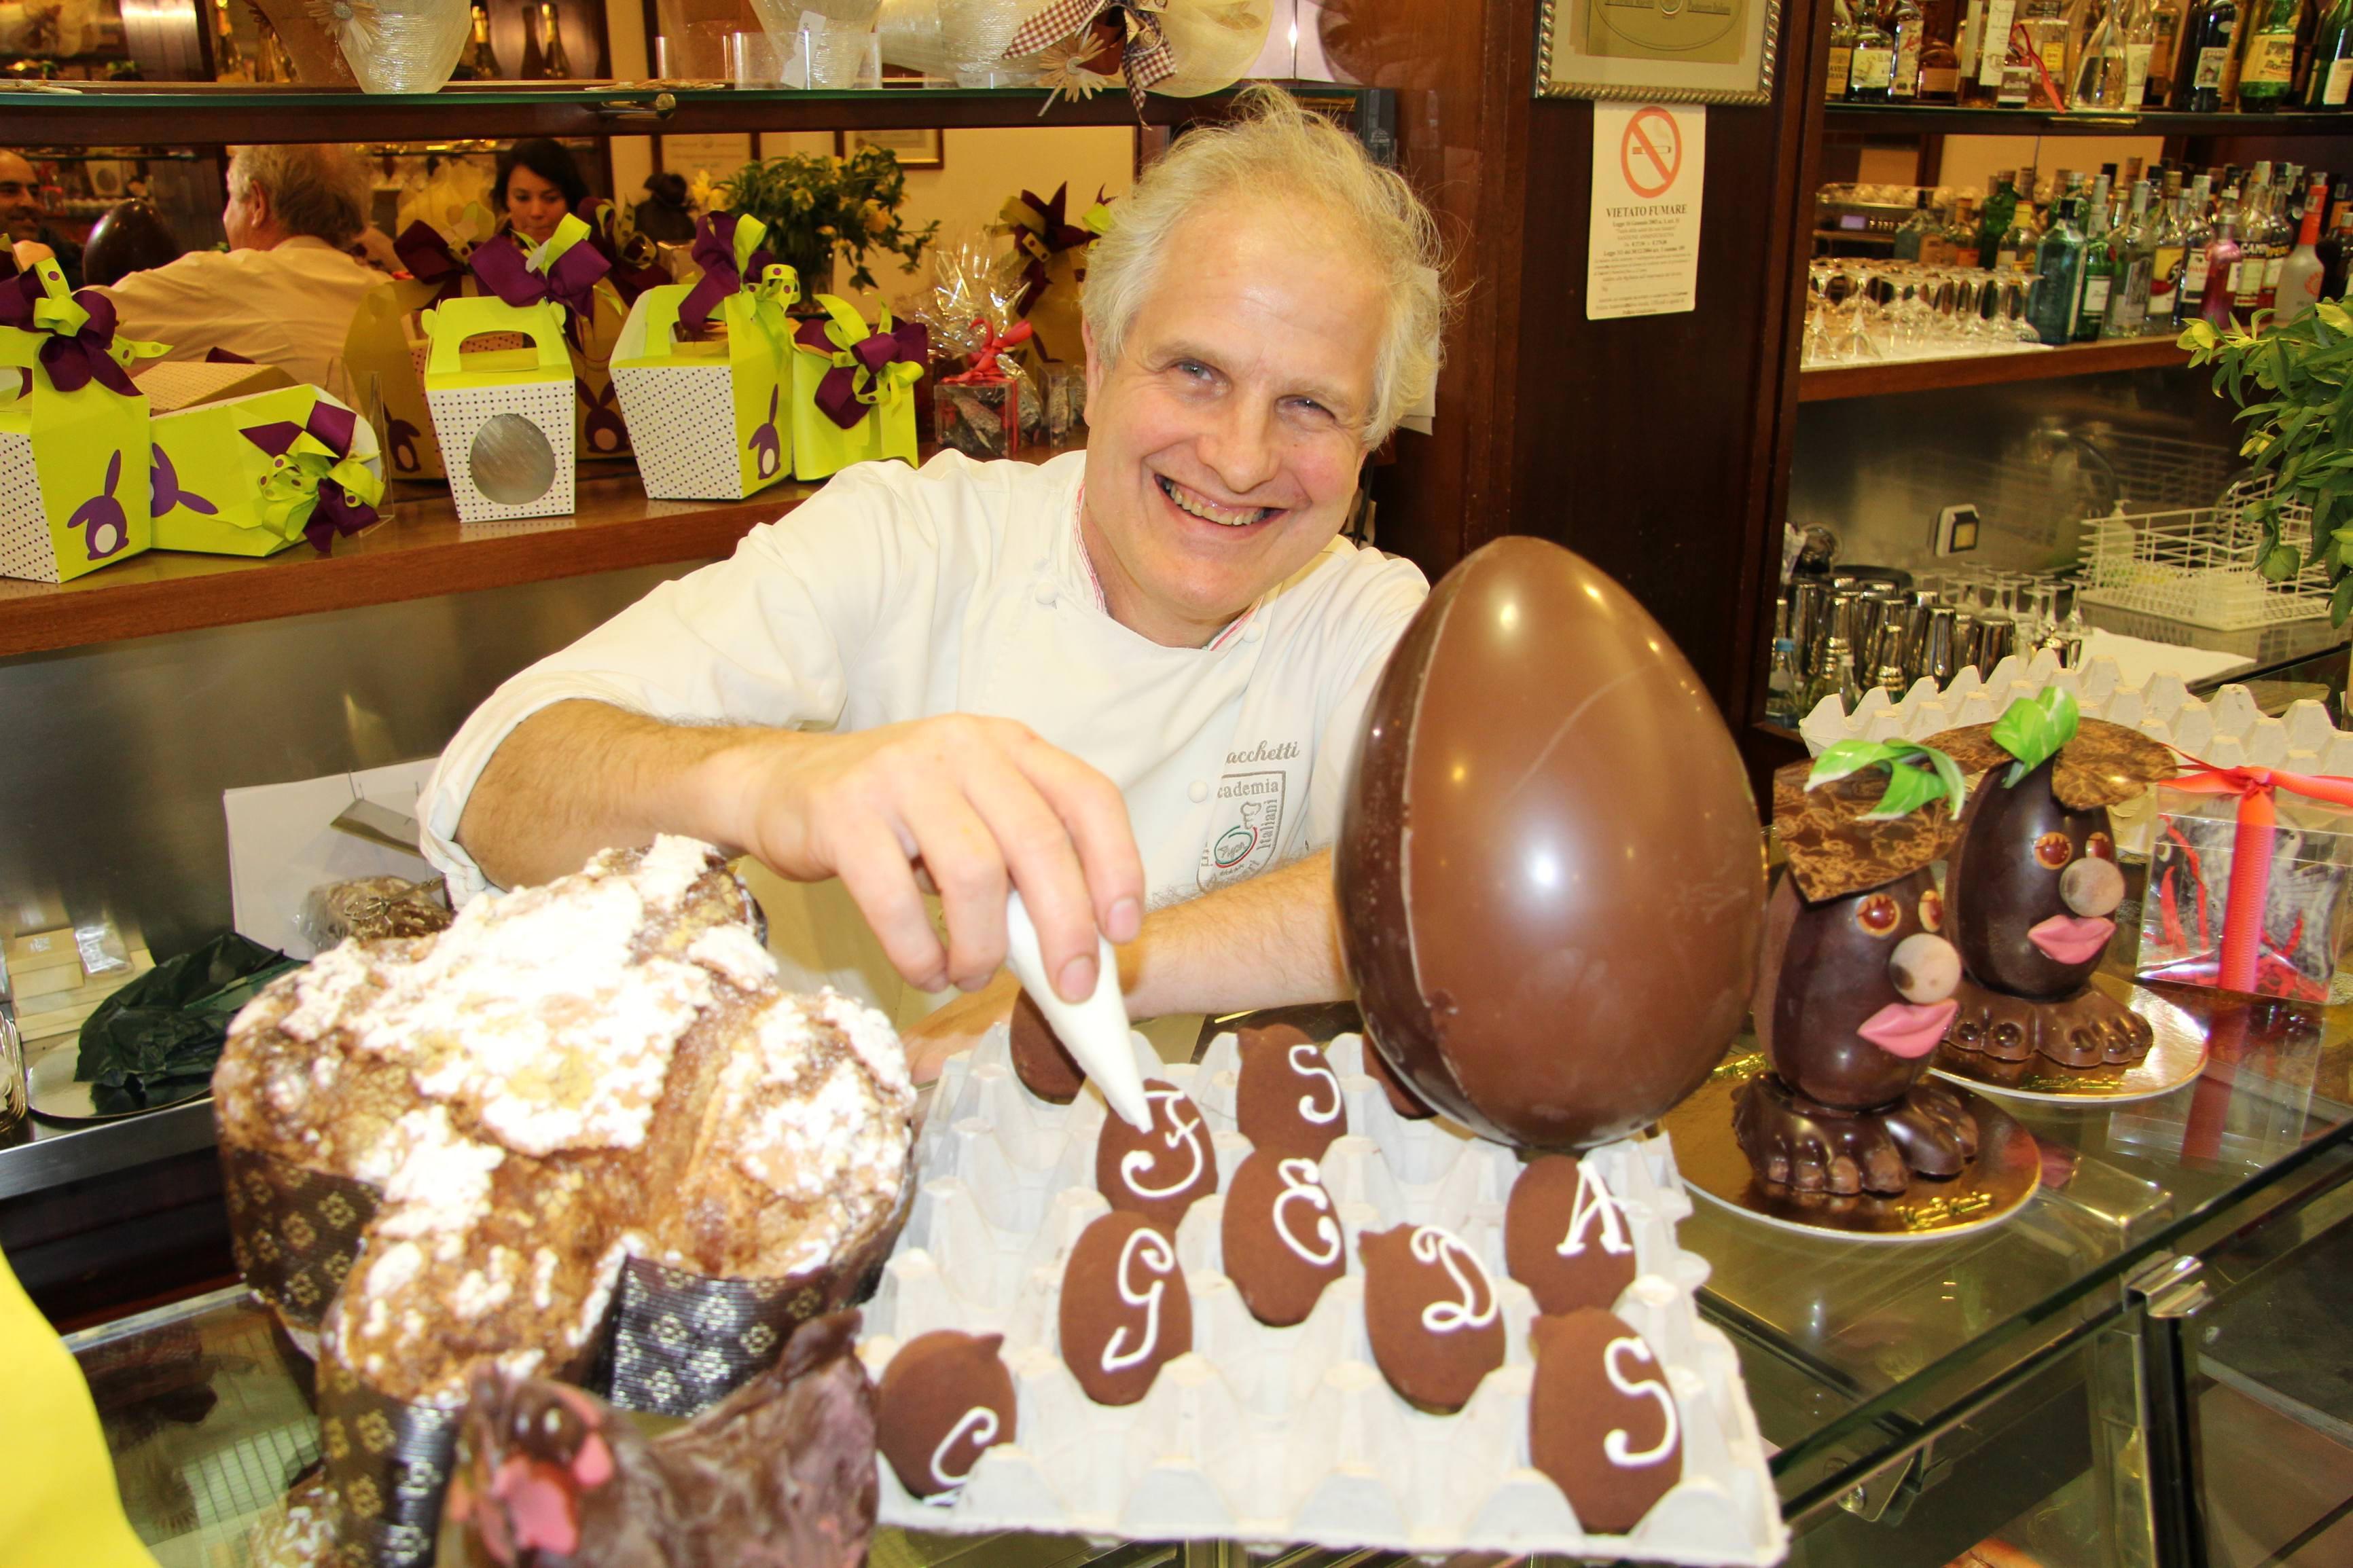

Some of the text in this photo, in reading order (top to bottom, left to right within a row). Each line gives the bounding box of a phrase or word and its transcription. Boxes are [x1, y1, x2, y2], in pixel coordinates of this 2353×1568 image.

[1606, 204, 1687, 218] VIETATO FUMARE
[1217, 779, 1279, 799] cademia
[1225, 739, 1300, 765] acchetti
[1289, 1043, 1343, 1125] S
[1272, 1157, 1342, 1266] E
[1556, 1160, 1633, 1257] A
[1409, 1224, 1500, 1334] D
[1603, 1336, 1681, 1469] S
